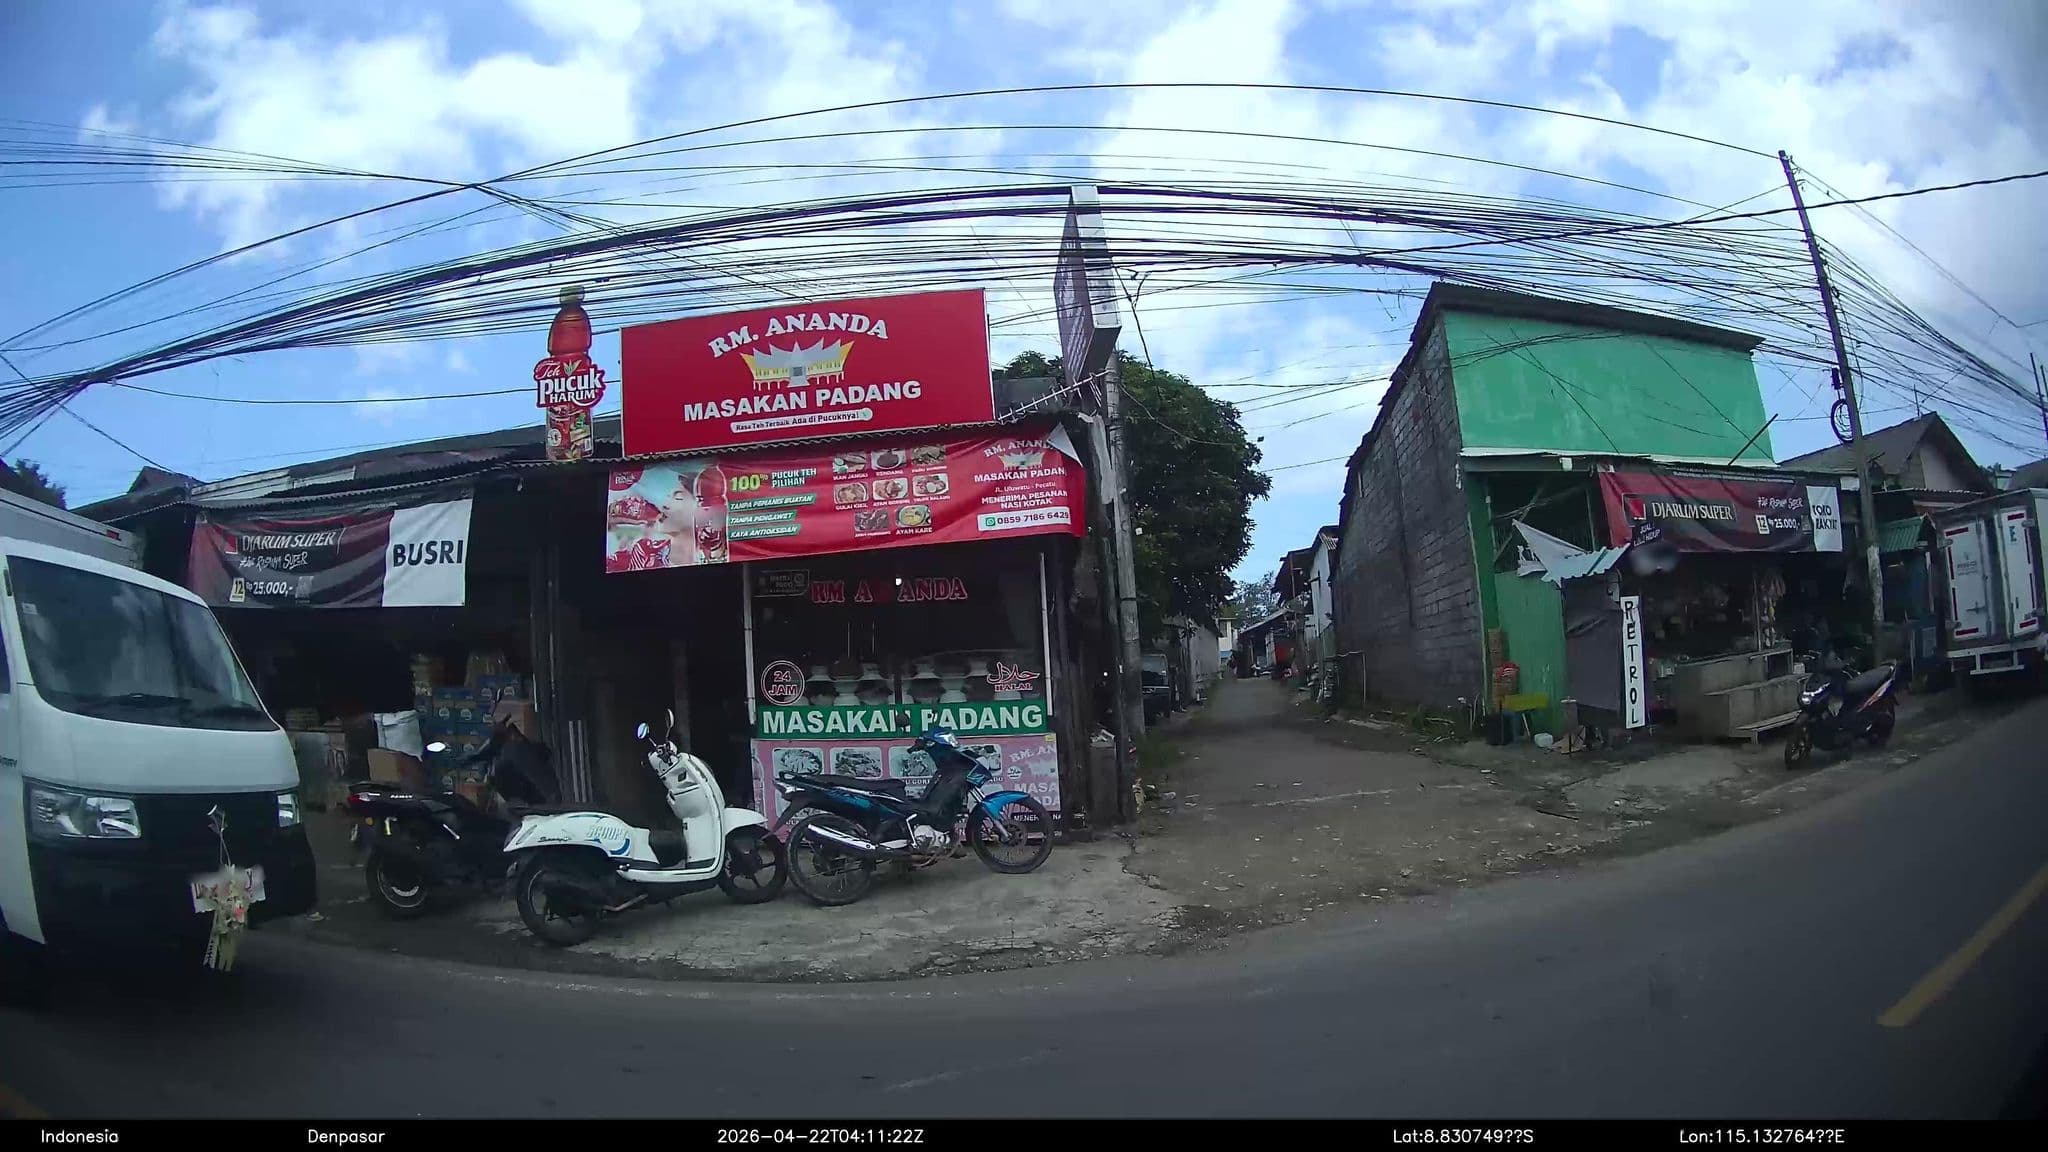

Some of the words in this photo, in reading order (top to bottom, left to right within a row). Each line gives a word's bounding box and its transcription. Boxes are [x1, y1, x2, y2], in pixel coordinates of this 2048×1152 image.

[708, 325, 759, 358] RM.
[765, 312, 889, 339] ANANDA
[535, 361, 560, 379] Teh
[550, 389, 596, 403] HARUM
[684, 391, 807, 422] MASAKAN
[816, 380, 922, 407] PADANG
[771, 470, 800, 480] PUCUK
[801, 468, 817, 477] TEH
[974, 471, 1027, 482] MASAKAN
[1030, 467, 1066, 477] PADAN
[730, 473, 769, 492] 100%
[771, 478, 805, 488] PILIHAN
[982, 493, 1027, 504] MENERIMA
[1000, 500, 1022, 509] NASI
[1023, 498, 1052, 507] KOTAK
[997, 514, 1021, 524] 0859
[1024, 512, 1045, 522] 7186
[1651, 502, 1700, 520] DJARUM
[1700, 504, 1733, 520] SUPER
[242, 535, 292, 552] DJARUM
[291, 532, 336, 548] SUPER
[393, 540, 463, 567] BUSRI
[811, 580, 845, 603] RM
[854, 576, 968, 602] AANDA
[774, 670, 791, 682] 24
[768, 684, 798, 697] JAM
[920, 705, 1043, 731] PADANG
